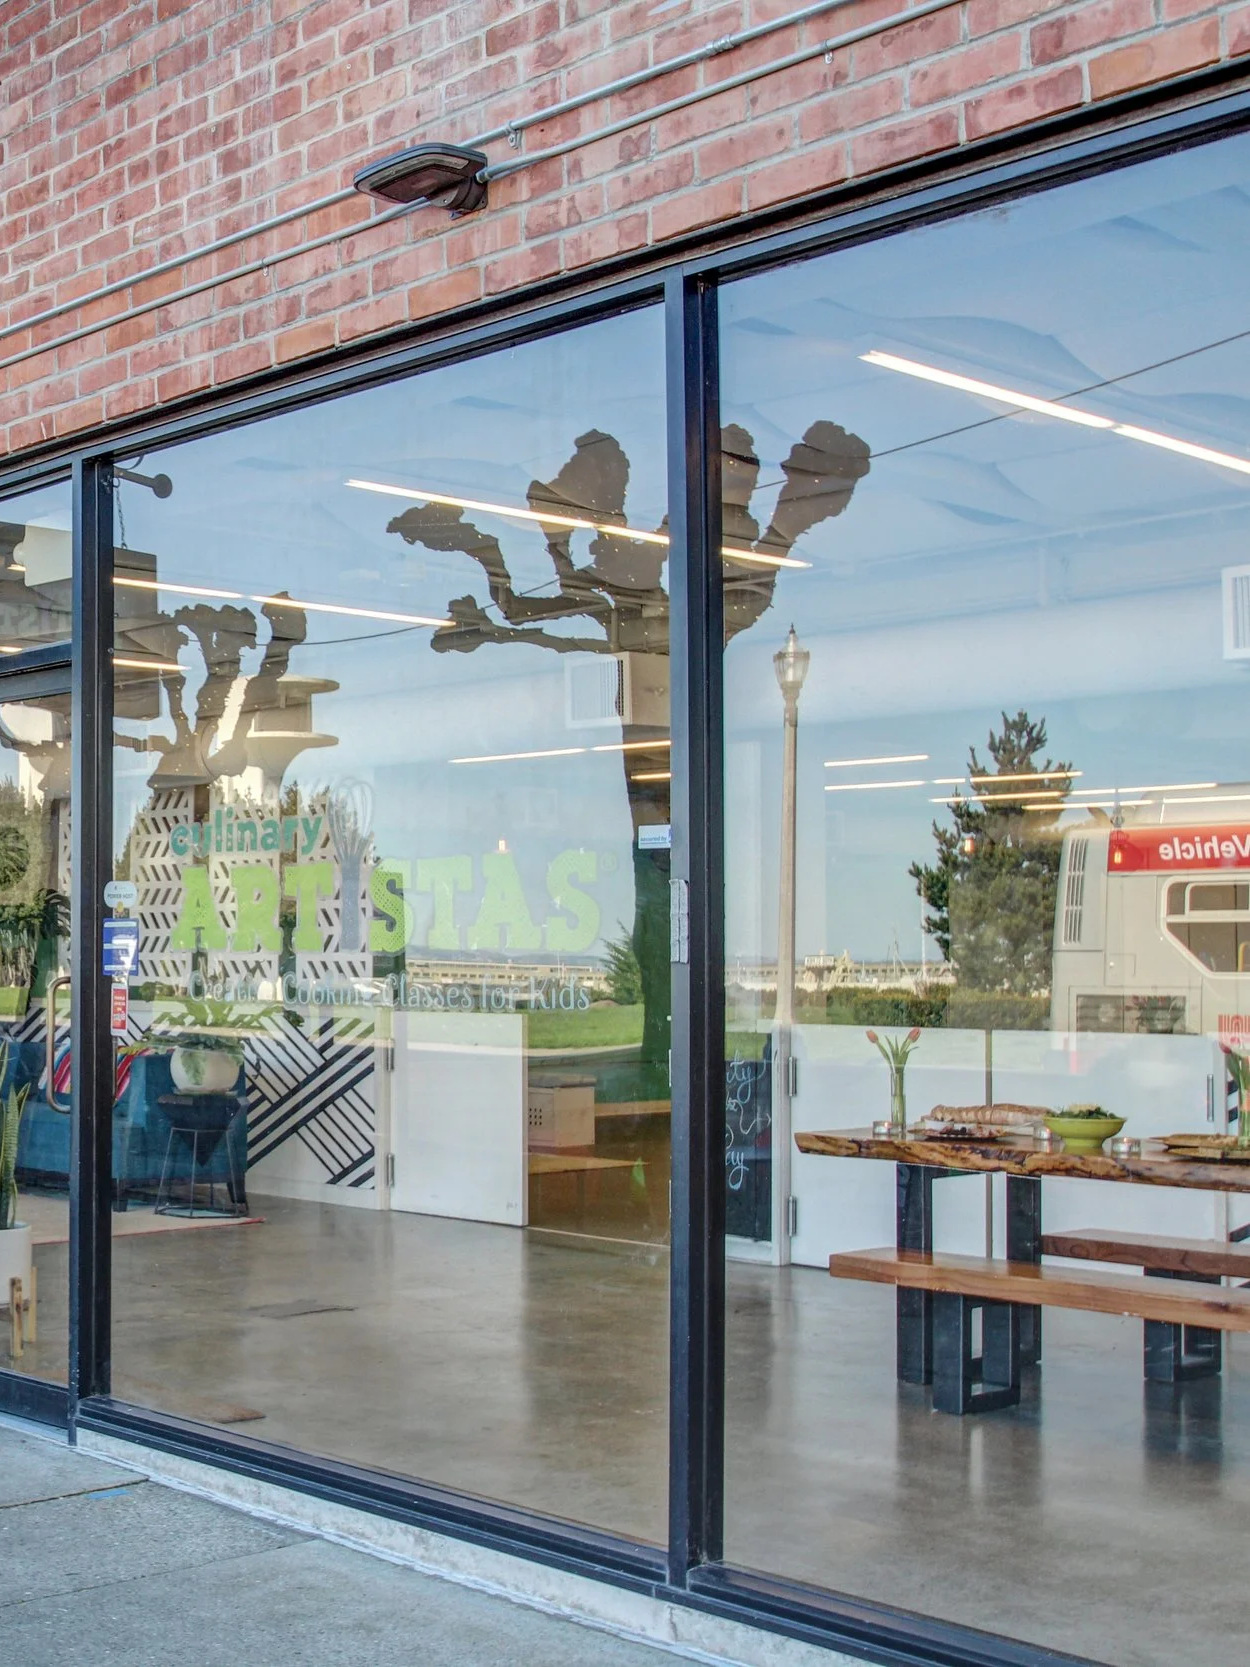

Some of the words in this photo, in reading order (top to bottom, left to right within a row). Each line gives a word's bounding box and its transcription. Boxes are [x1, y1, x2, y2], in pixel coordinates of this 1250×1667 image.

[171, 807, 323, 857] culinary
[382, 971, 472, 1008] Classes
[481, 974, 517, 1011] for
[529, 973, 591, 1011] Kids
